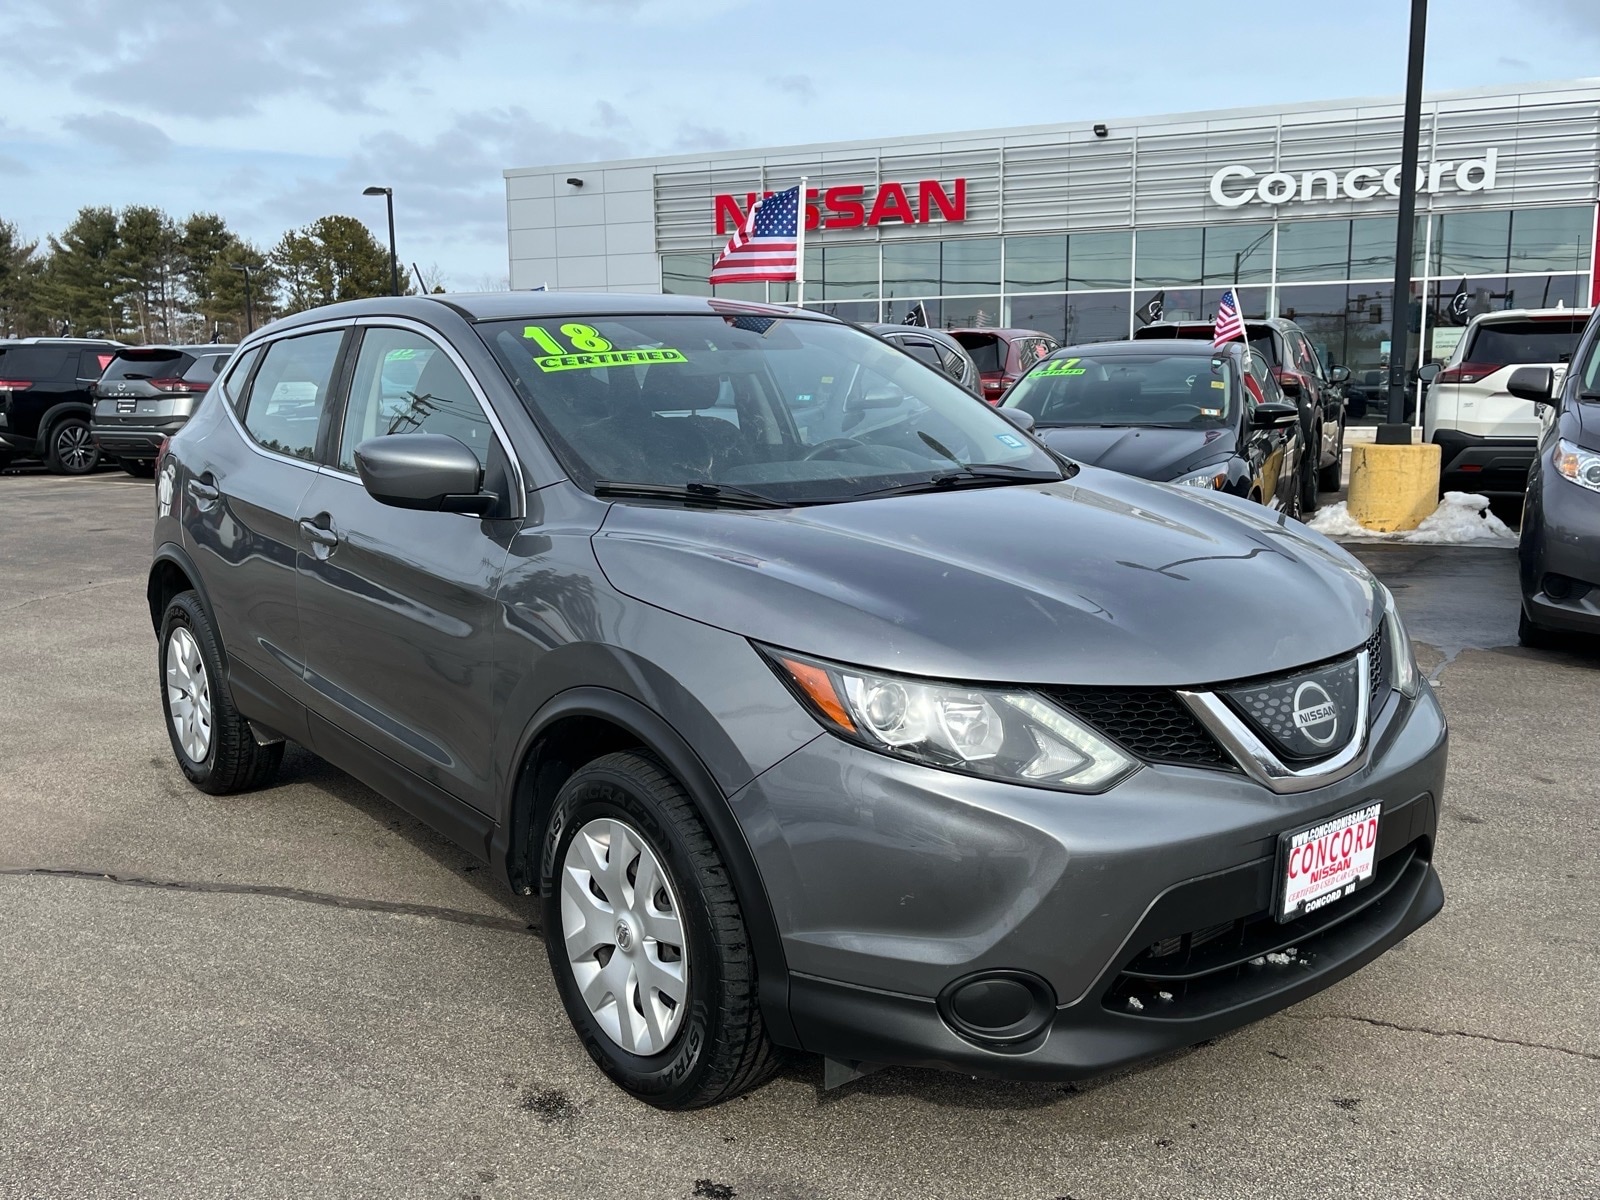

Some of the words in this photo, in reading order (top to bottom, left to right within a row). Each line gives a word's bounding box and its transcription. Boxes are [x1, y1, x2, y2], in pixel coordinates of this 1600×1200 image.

[1210, 148, 1498, 207] Concord
[715, 178, 967, 235] NSAN
[523, 324, 613, 355] 18
[540, 351, 681, 368] CERTIFIED
[1047, 358, 1082, 371] 17
[1299, 705, 1335, 723] NISSAN
[1289, 819, 1377, 879] CONCORD
[1288, 883, 1319, 903] CERTIFIED
[1320, 876, 1335, 890] USED
[1336, 871, 1348, 884] CAR
[1347, 863, 1370, 876] CENTER
[1310, 857, 1352, 884] NISSAN
[1305, 889, 1342, 913] CONCORD
[1345, 882, 1357, 896] NH
